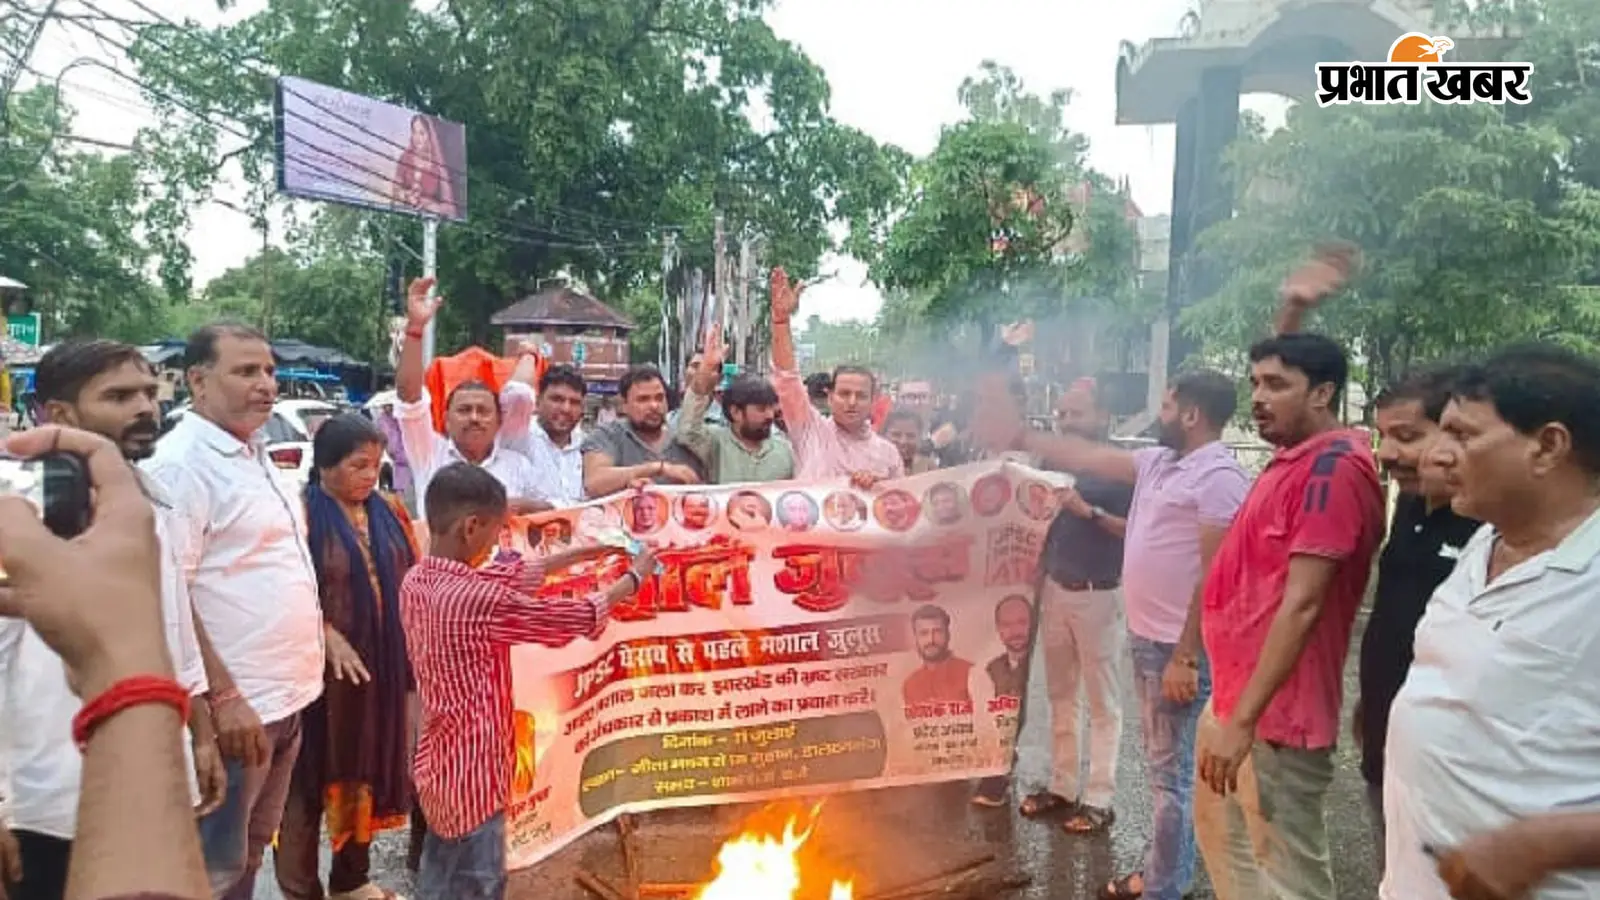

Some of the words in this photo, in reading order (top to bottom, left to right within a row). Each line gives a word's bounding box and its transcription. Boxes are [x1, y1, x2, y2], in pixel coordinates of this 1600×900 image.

[574, 652, 615, 698] JPSC
[674, 640, 696, 665] से
[702, 634, 749, 661] पहले
[759, 631, 820, 655] मशाल
[679, 681, 707, 697] कर
[775, 668, 798, 686] की
[717, 701, 732, 720] में
[771, 699, 794, 714] का
